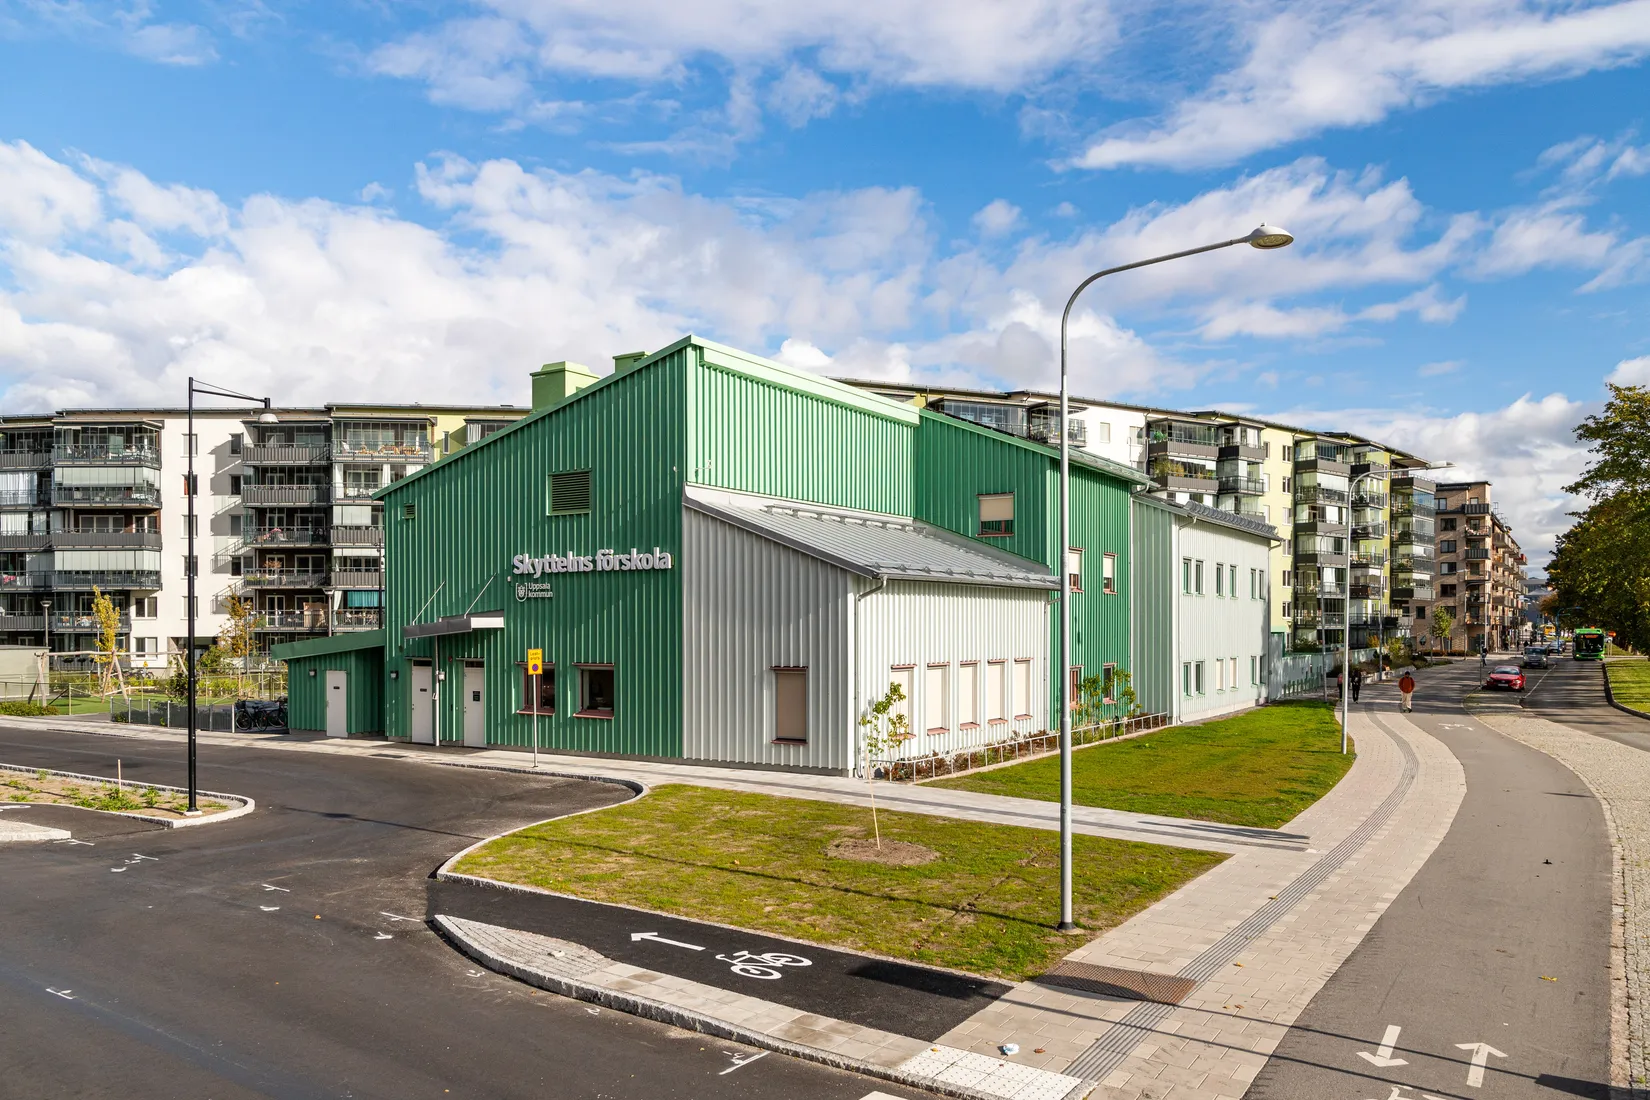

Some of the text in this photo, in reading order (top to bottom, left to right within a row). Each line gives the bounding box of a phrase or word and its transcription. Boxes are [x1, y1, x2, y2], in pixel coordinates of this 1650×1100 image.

[513, 547, 671, 578] Skyttelns förskola
[528, 582, 551, 591] Uppsala
[528, 590, 554, 598] kommun
